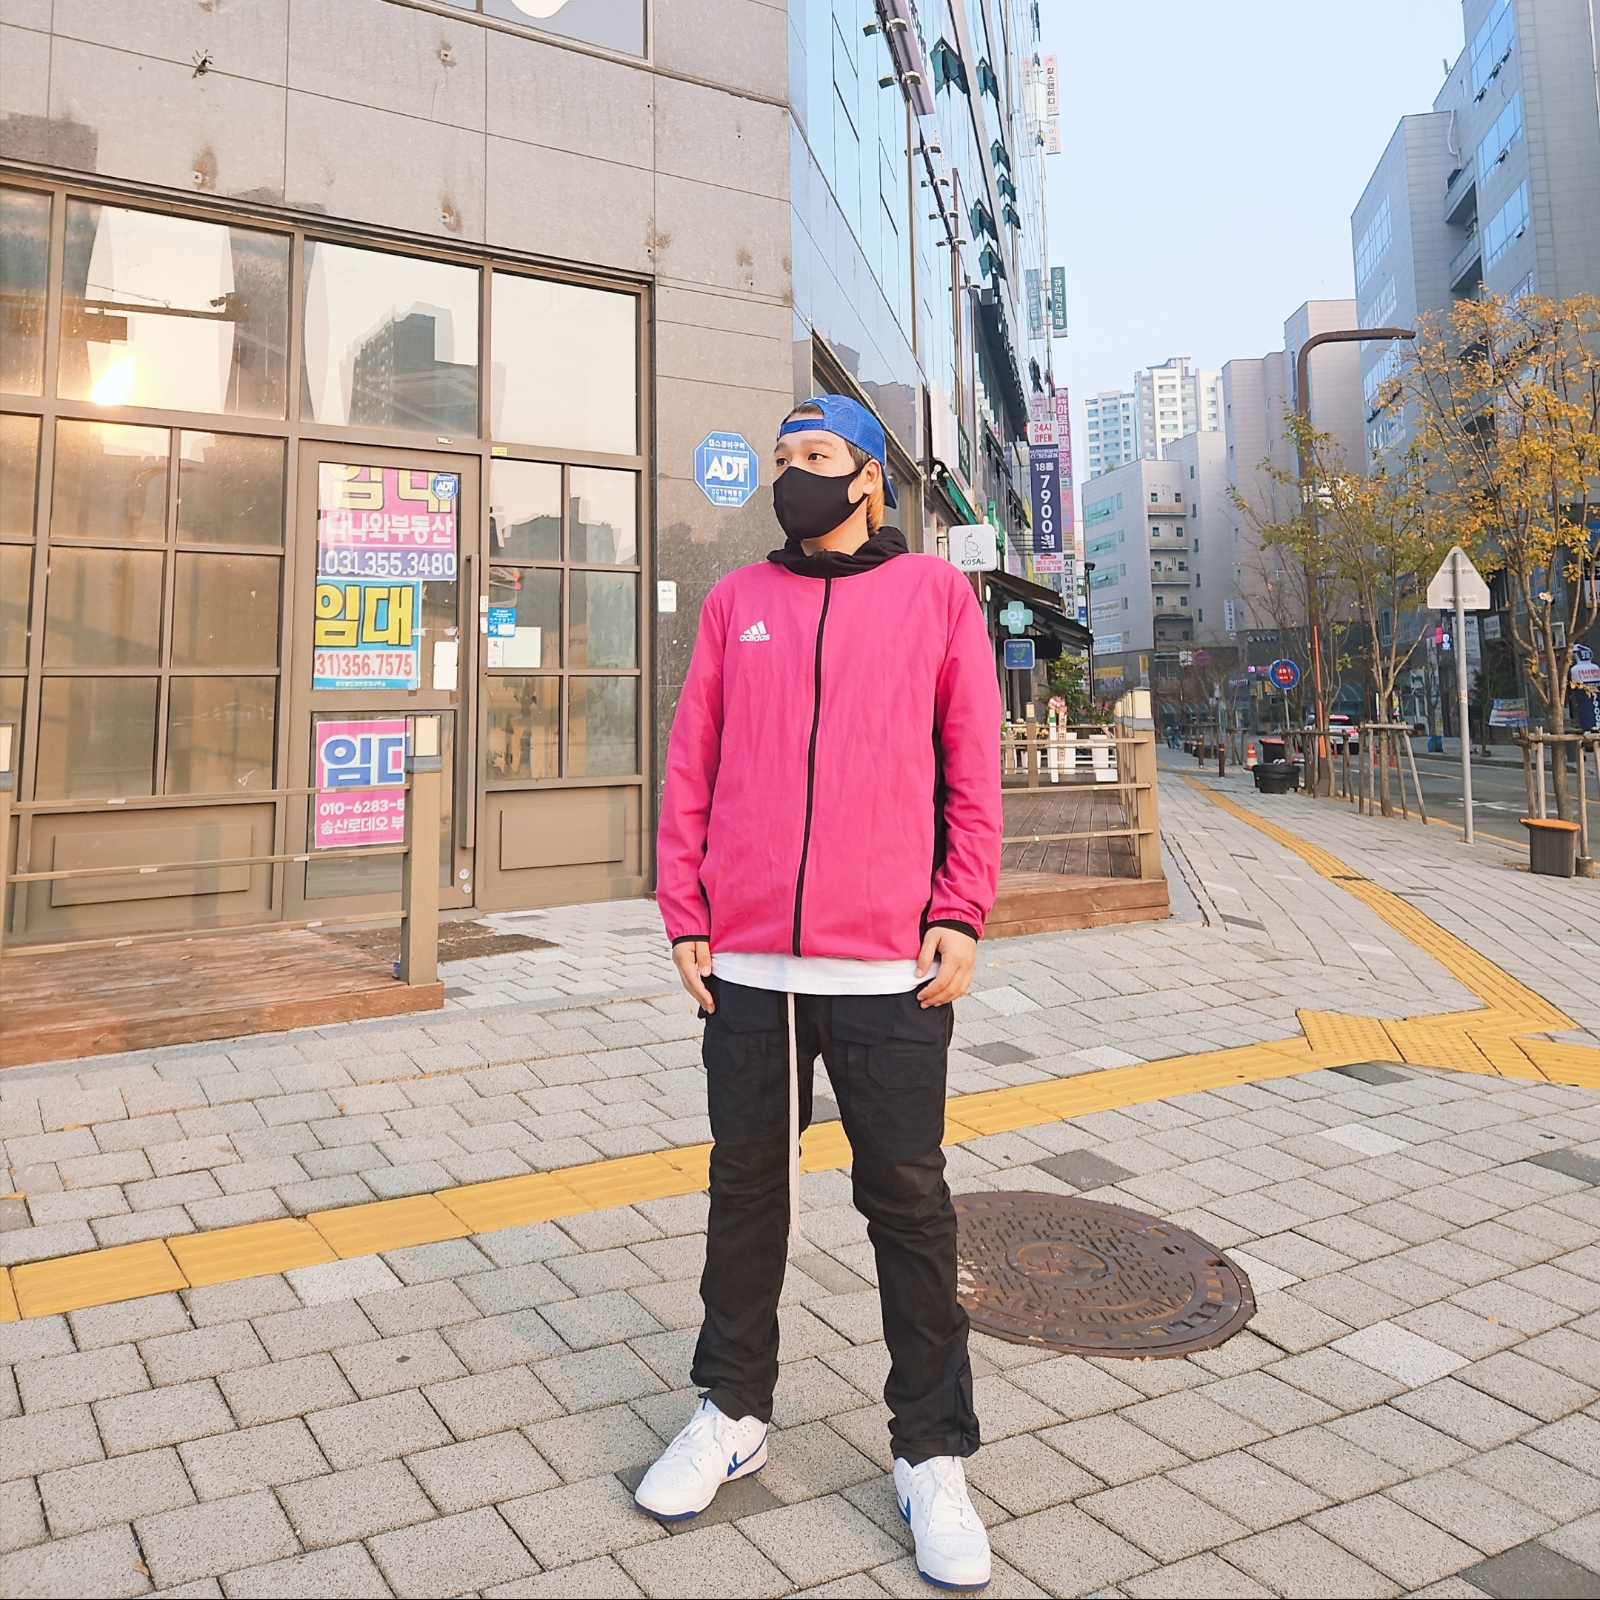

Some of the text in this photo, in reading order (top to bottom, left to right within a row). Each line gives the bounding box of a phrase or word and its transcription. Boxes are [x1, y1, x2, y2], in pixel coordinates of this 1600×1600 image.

[1034, 422, 1052, 433] 24시
[1057, 405, 1069, 437] 아로마
[1034, 433, 1053, 443] OPEN
[706, 455, 749, 483] ADT
[326, 511, 453, 545] 다나와부동산
[961, 558, 987, 567] KOSAL
[315, 583, 414, 647] 임대
[1008, 611, 1024, 627] 약
[739, 633, 771, 642] adidas
[320, 816, 389, 836] 송산로데오
